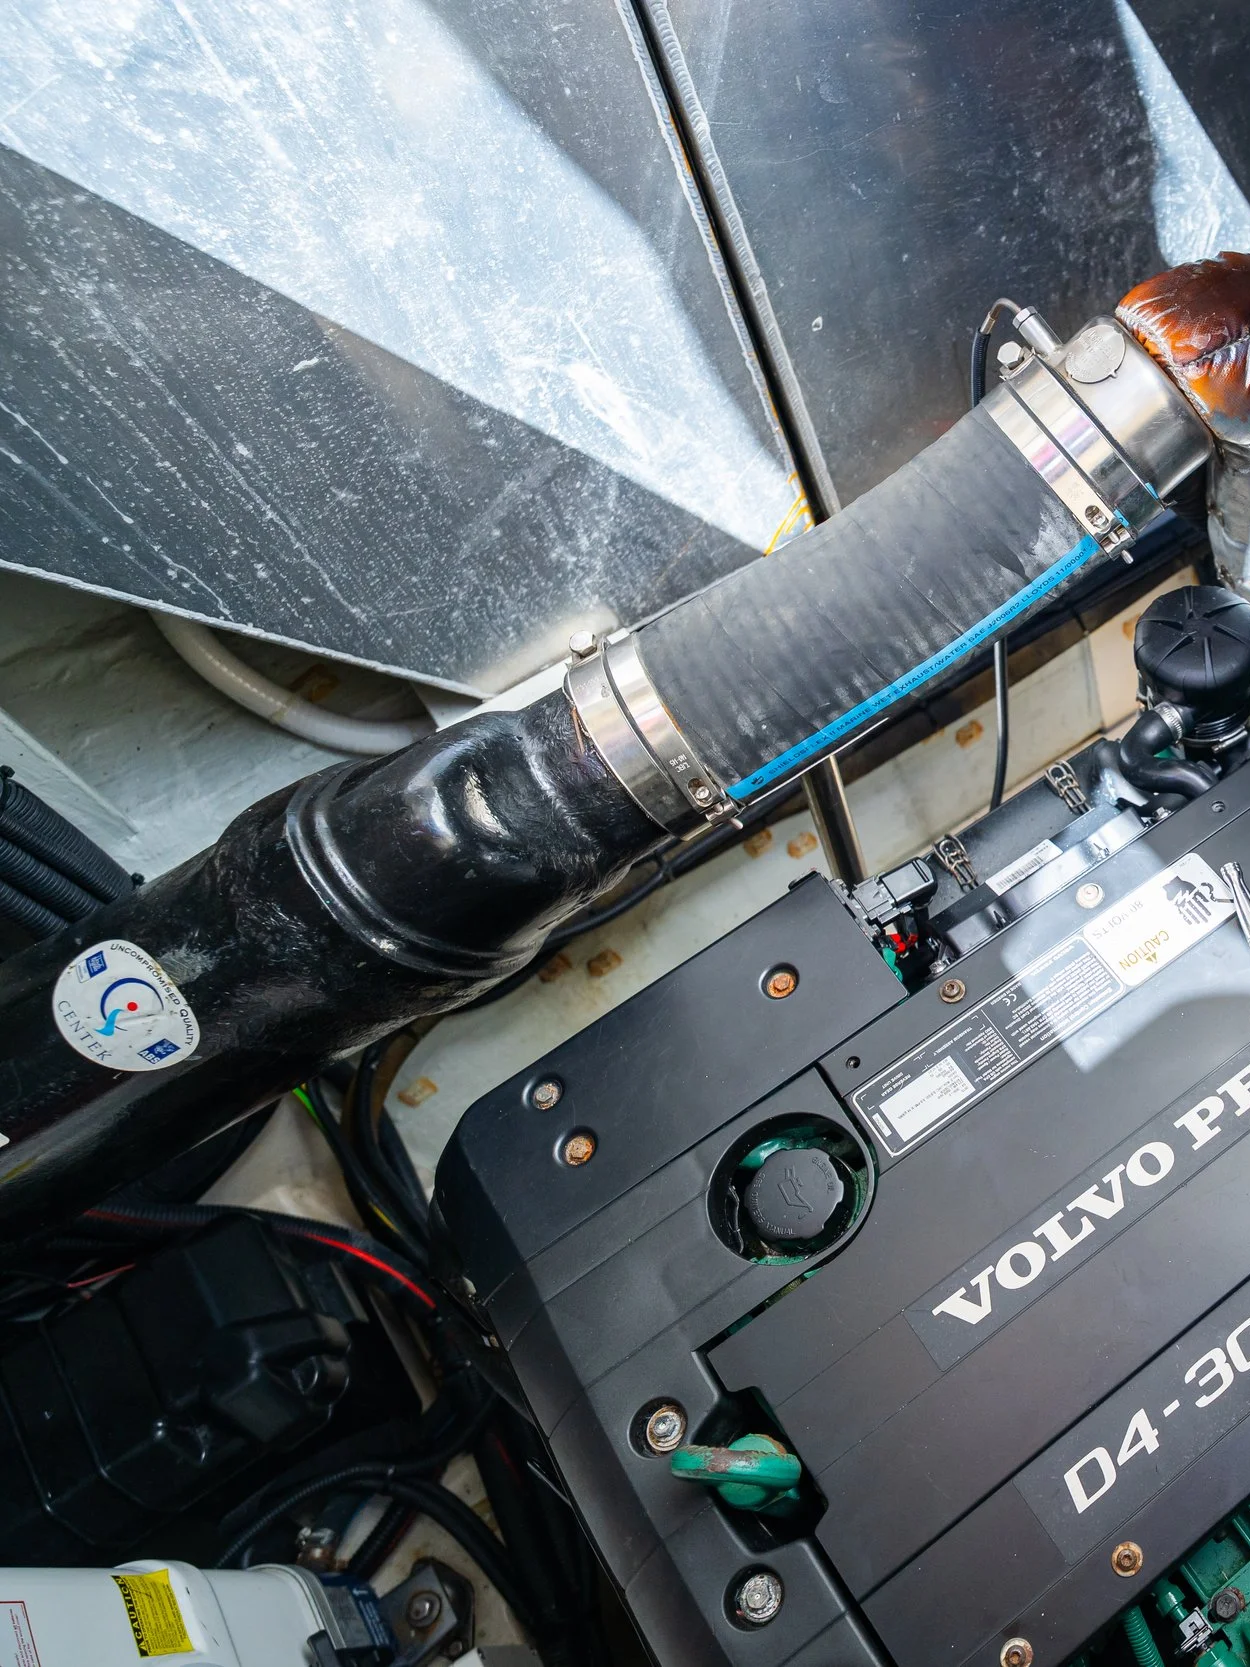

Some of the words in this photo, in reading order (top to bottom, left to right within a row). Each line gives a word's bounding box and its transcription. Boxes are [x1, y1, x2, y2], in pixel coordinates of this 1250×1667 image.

[835, 706, 871, 731] MARINE
[871, 692, 892, 708] WET
[893, 640, 967, 696] EXHAUST/WATER
[967, 627, 985, 642] SAE
[1021, 575, 1055, 603] LLOYDS
[1116, 928, 1171, 971] CAUTION
[1002, 991, 1018, 1006] CE
[57, 1000, 114, 1063] CENTEK
[178, 1008, 195, 1047] QUALITY
[138, 1048, 161, 1065] ABS
[932, 1141, 1176, 1326] VOLVO
[115, 1576, 142, 1638] CAUTION
